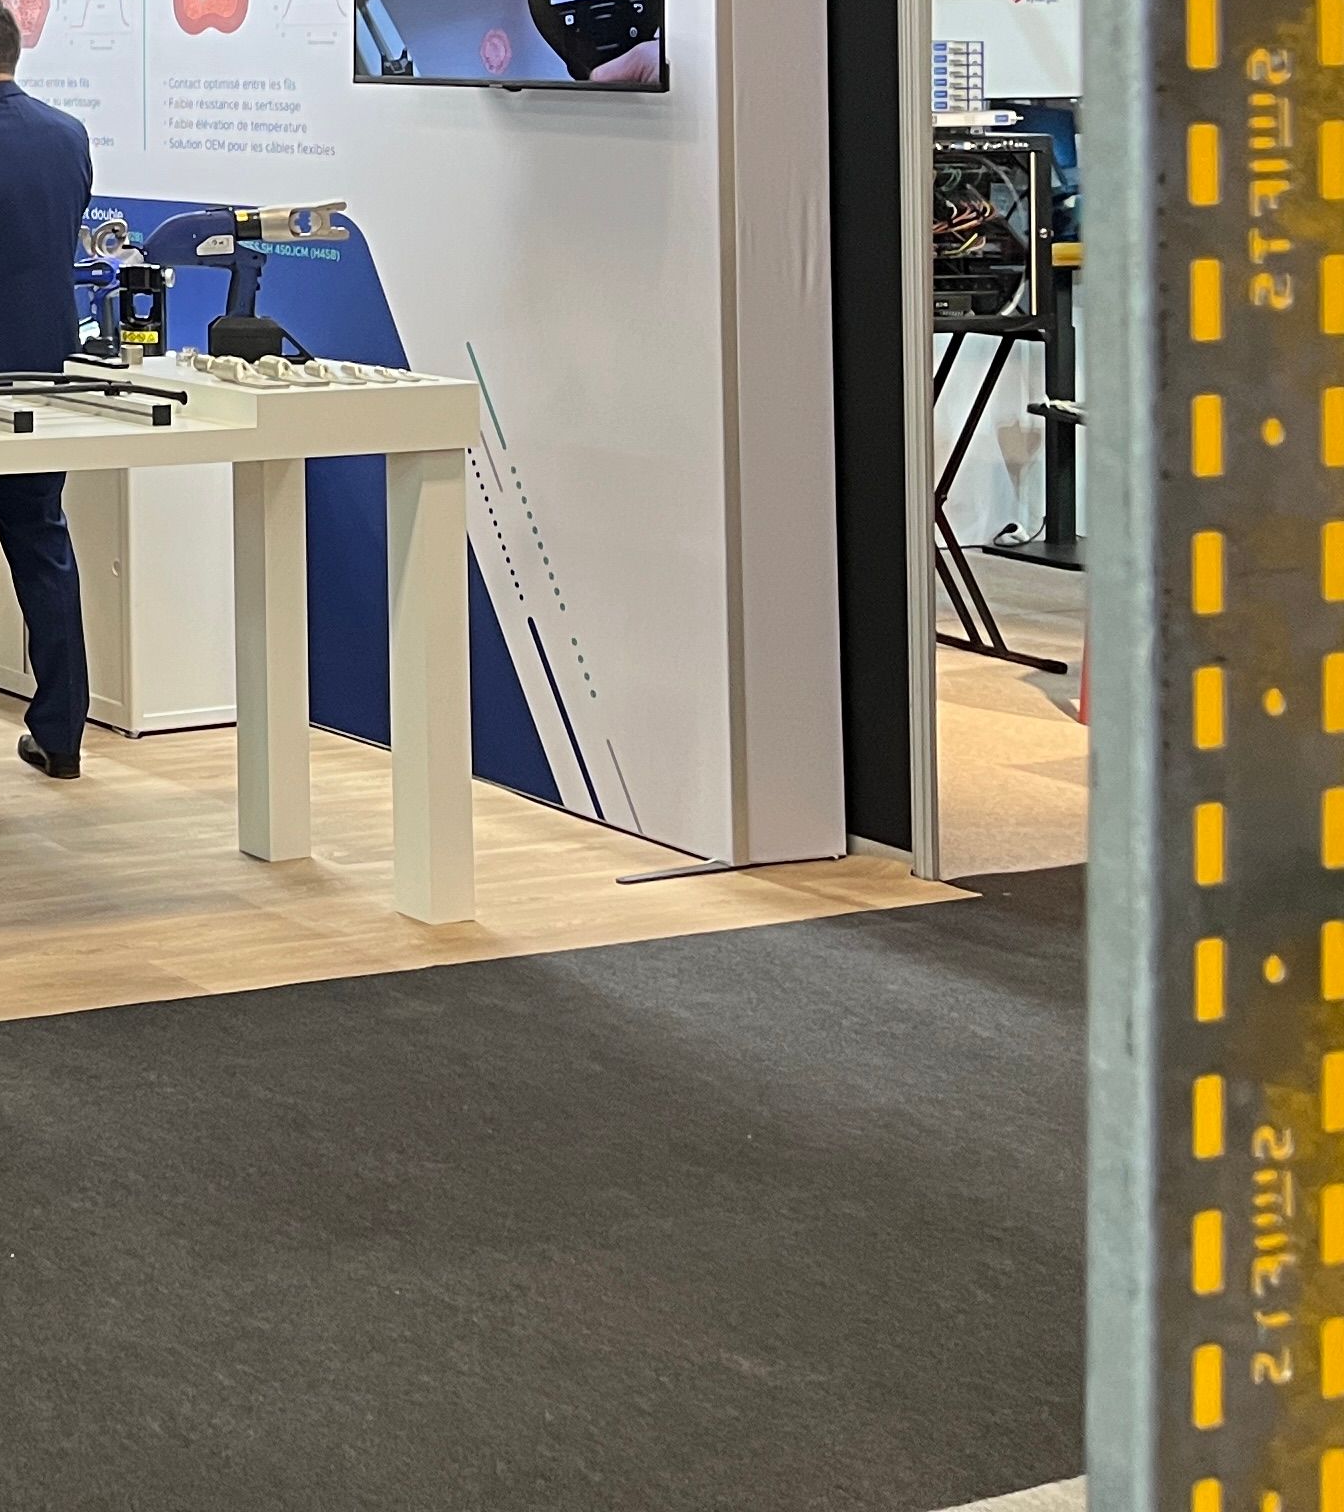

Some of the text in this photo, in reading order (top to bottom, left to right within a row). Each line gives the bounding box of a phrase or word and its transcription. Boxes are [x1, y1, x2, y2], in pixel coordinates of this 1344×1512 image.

[168, 77, 201, 90] Contact
[242, 79, 266, 90] entre
[268, 78, 281, 90] les
[255, 99, 301, 114] sertissage
[237, 119, 248, 131] de
[169, 137, 203, 150] Solution
[205, 138, 225, 151] OEM
[228, 140, 248, 153] pour
